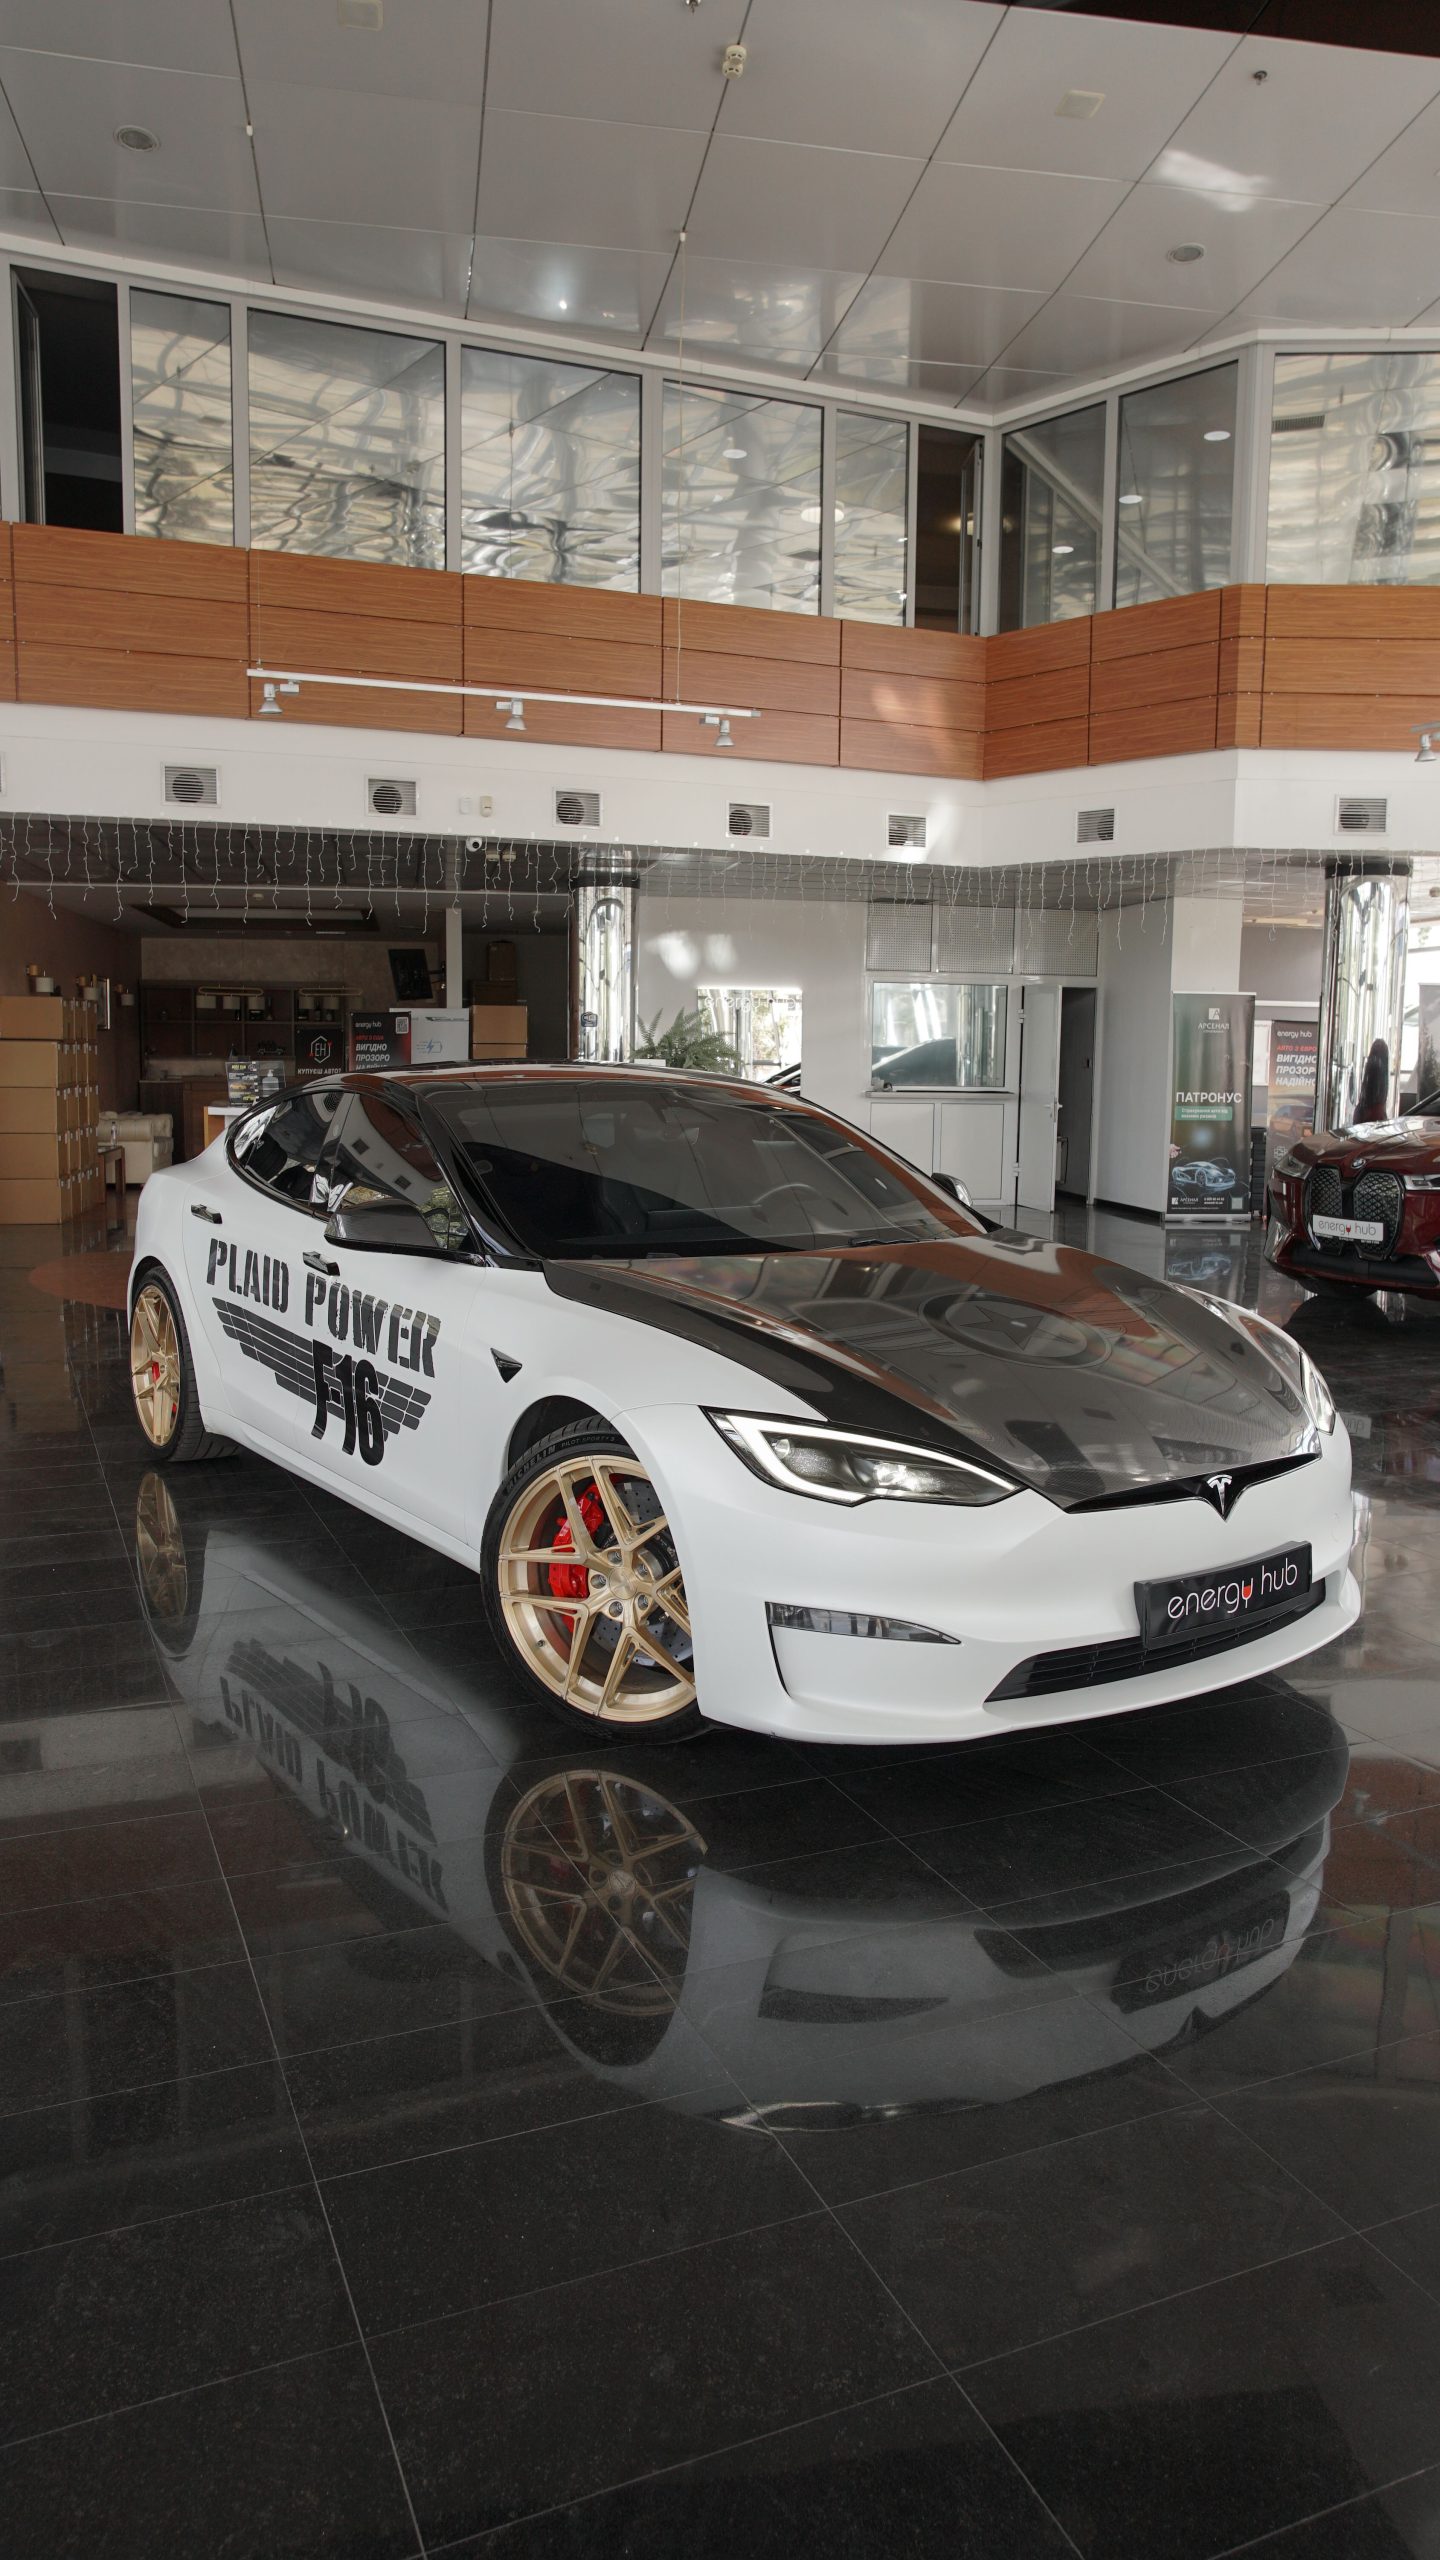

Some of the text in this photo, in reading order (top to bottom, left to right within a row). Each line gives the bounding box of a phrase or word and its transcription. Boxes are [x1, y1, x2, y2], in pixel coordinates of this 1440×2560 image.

[1198, 1022, 1229, 1030] АРСЕНАЛ
[356, 1043, 387, 1052] ВИГІДНО
[356, 1054, 390, 1062] ПРОЗОРО
[1176, 1092, 1242, 1103] ПАТРОНУС
[1318, 1220, 1352, 1236] energy
[1354, 1222, 1376, 1236] hub
[206, 1238, 441, 1378] PLAID POWER
[506, 1445, 556, 1492] MICHELIN
[561, 1439, 580, 1448] PILOT
[1167, 1558, 1298, 1619] energy hub
